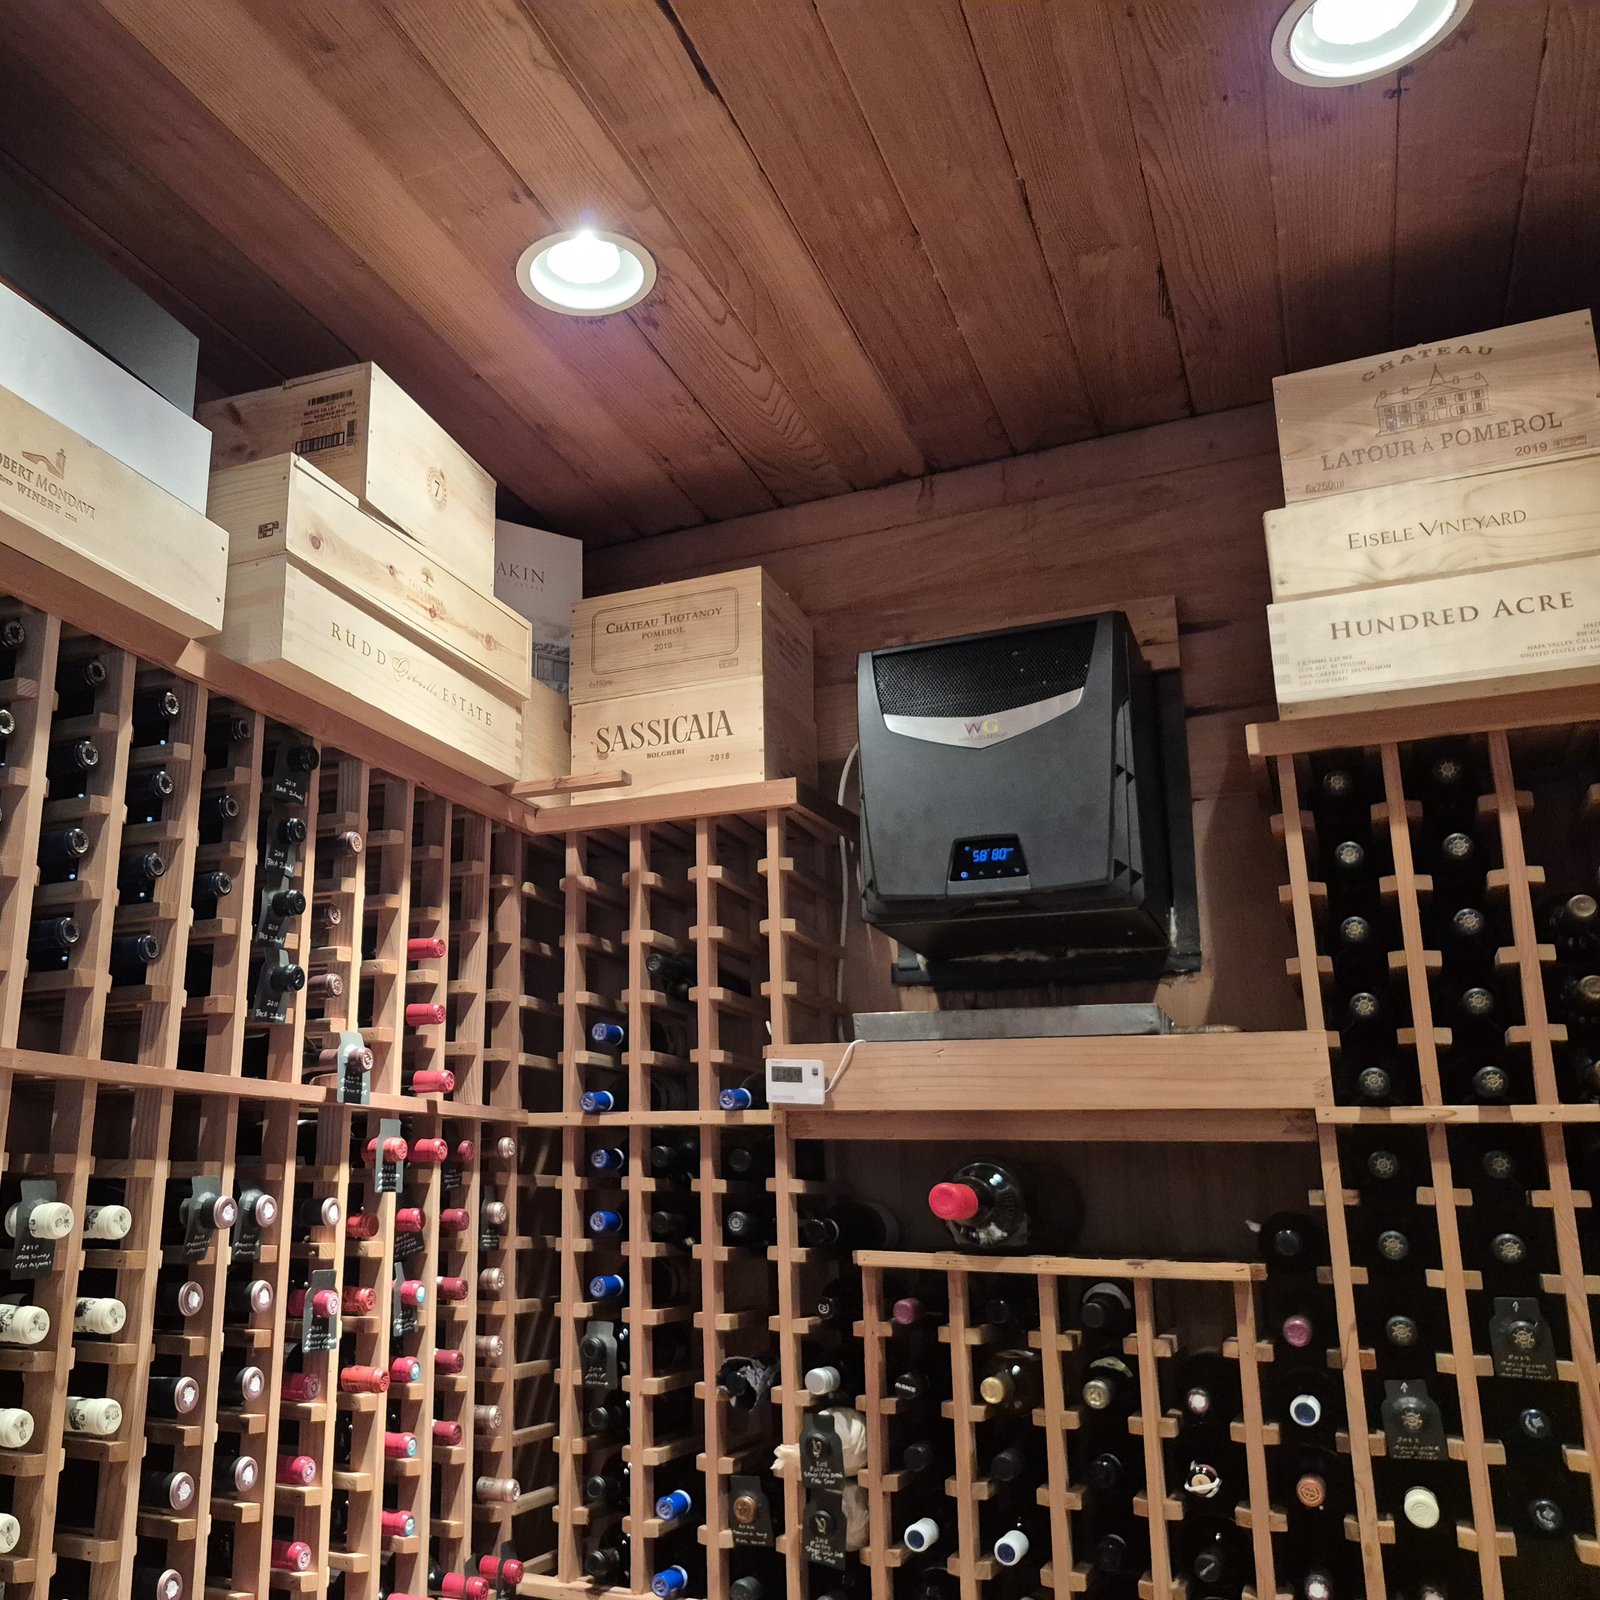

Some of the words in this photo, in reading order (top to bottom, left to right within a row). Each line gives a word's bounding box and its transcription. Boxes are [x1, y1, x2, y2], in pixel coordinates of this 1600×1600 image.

[1321, 439, 1415, 471] LATOUR
[1441, 411, 1562, 449] POMEROL
[1514, 441, 1548, 457] 2019
[17, 481, 62, 514] WINERY
[35, 474, 95, 520] MONDAVI
[496, 562, 545, 583] AKIN
[662, 607, 723, 625] TROTANOY
[1330, 605, 1479, 640] HUNDRED
[1492, 591, 1574, 619] ACRE
[641, 626, 685, 640] POMEROL
[331, 622, 386, 665] RUDD
[442, 687, 492, 726] ESTATE
[596, 709, 735, 755] SASSICAIA
[646, 748, 685, 759] BOLGHERI
